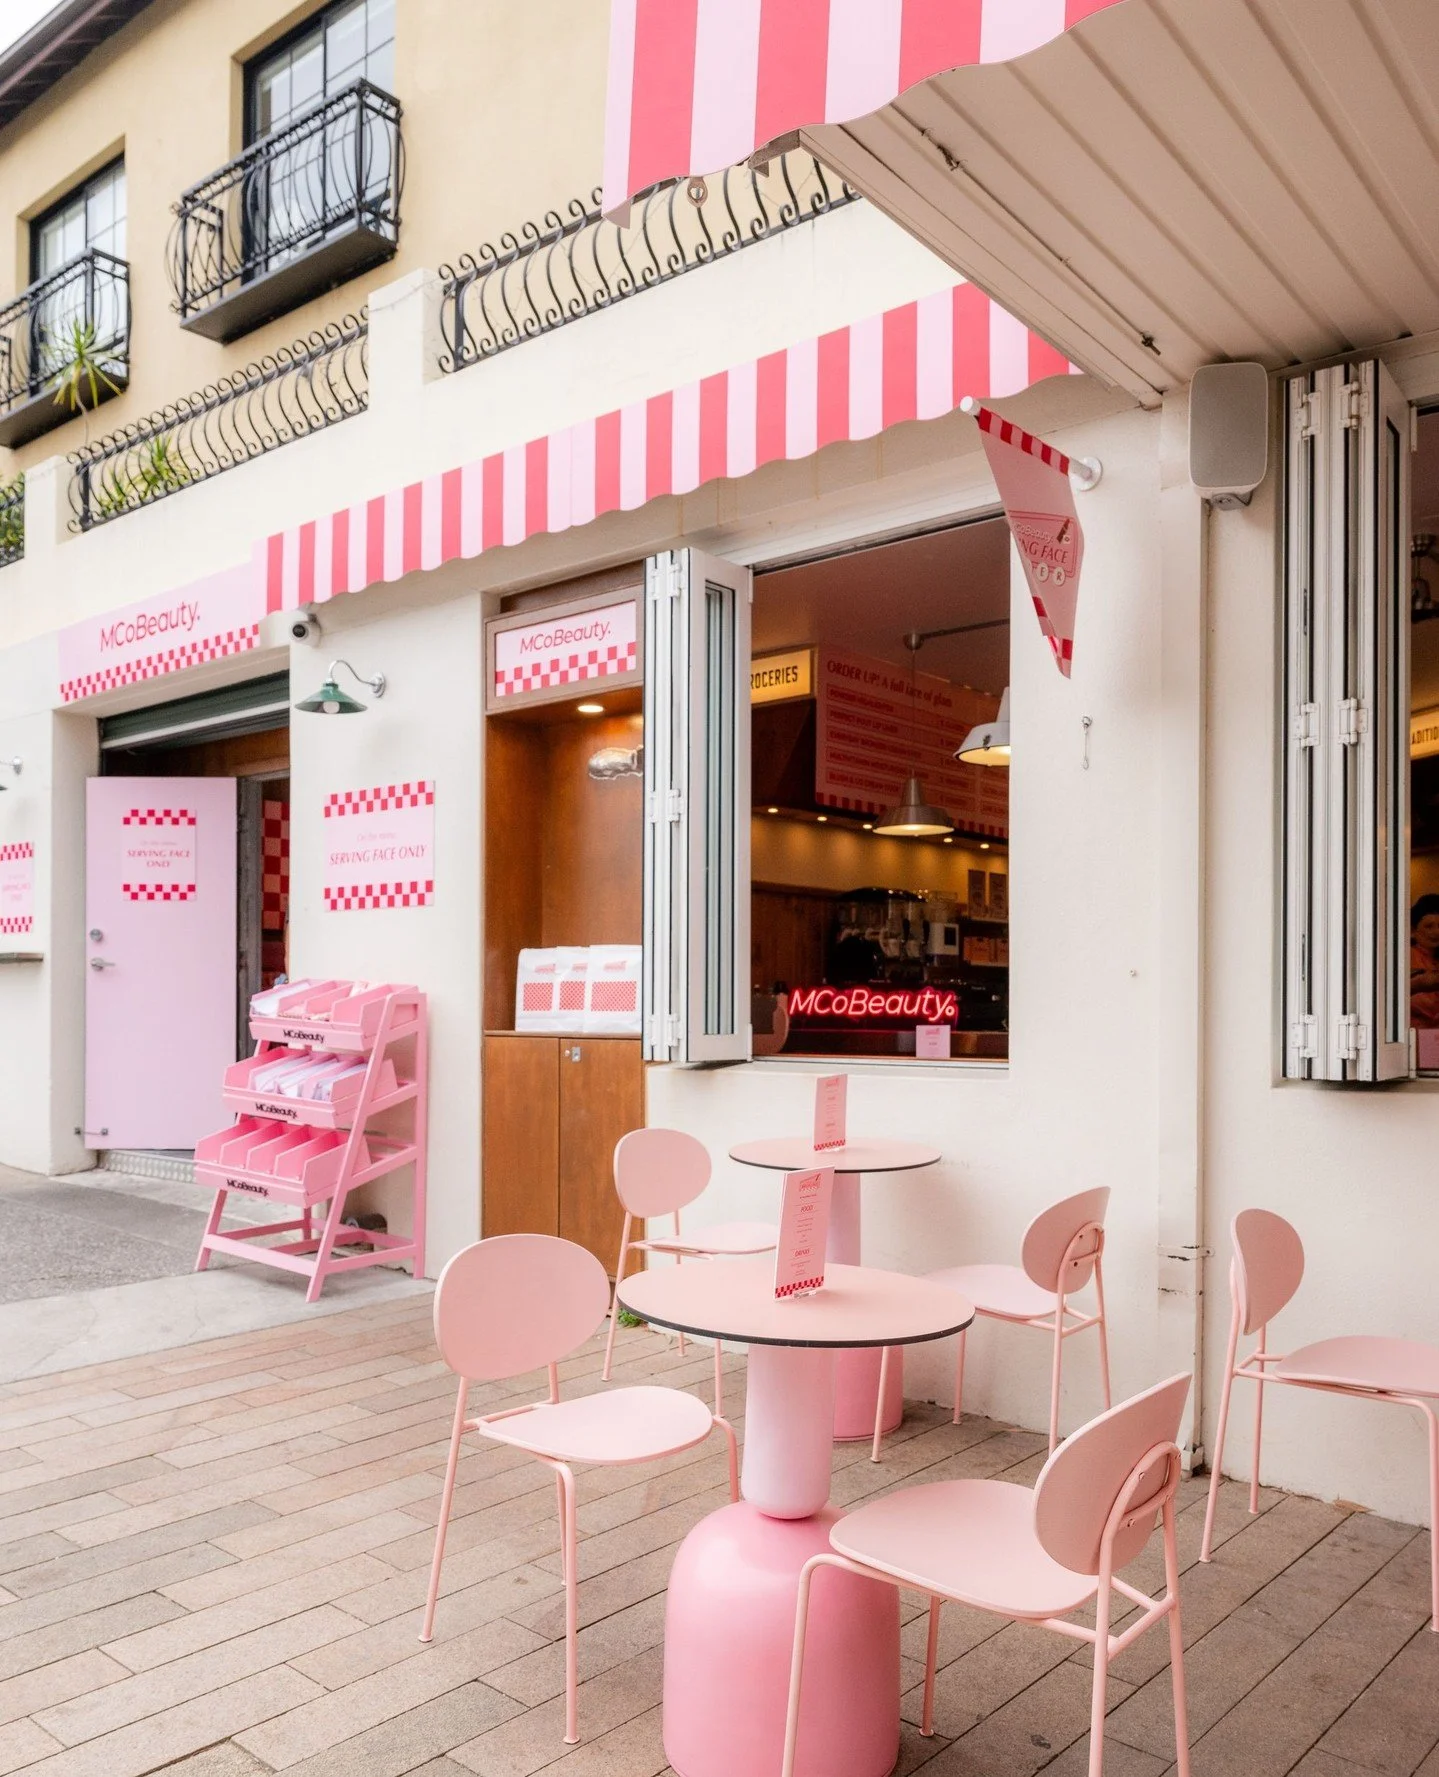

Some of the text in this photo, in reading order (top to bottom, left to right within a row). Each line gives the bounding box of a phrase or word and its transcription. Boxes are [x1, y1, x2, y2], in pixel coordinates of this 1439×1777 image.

[1041, 546, 1069, 564] FACE
[100, 600, 200, 653] MCoBeauty.
[519, 621, 611, 654] MCoBeauty.
[827, 660, 861, 681] ORDER
[127, 849, 191, 858] SERVING FACE
[329, 844, 427, 866] SERVING FACE ONLY
